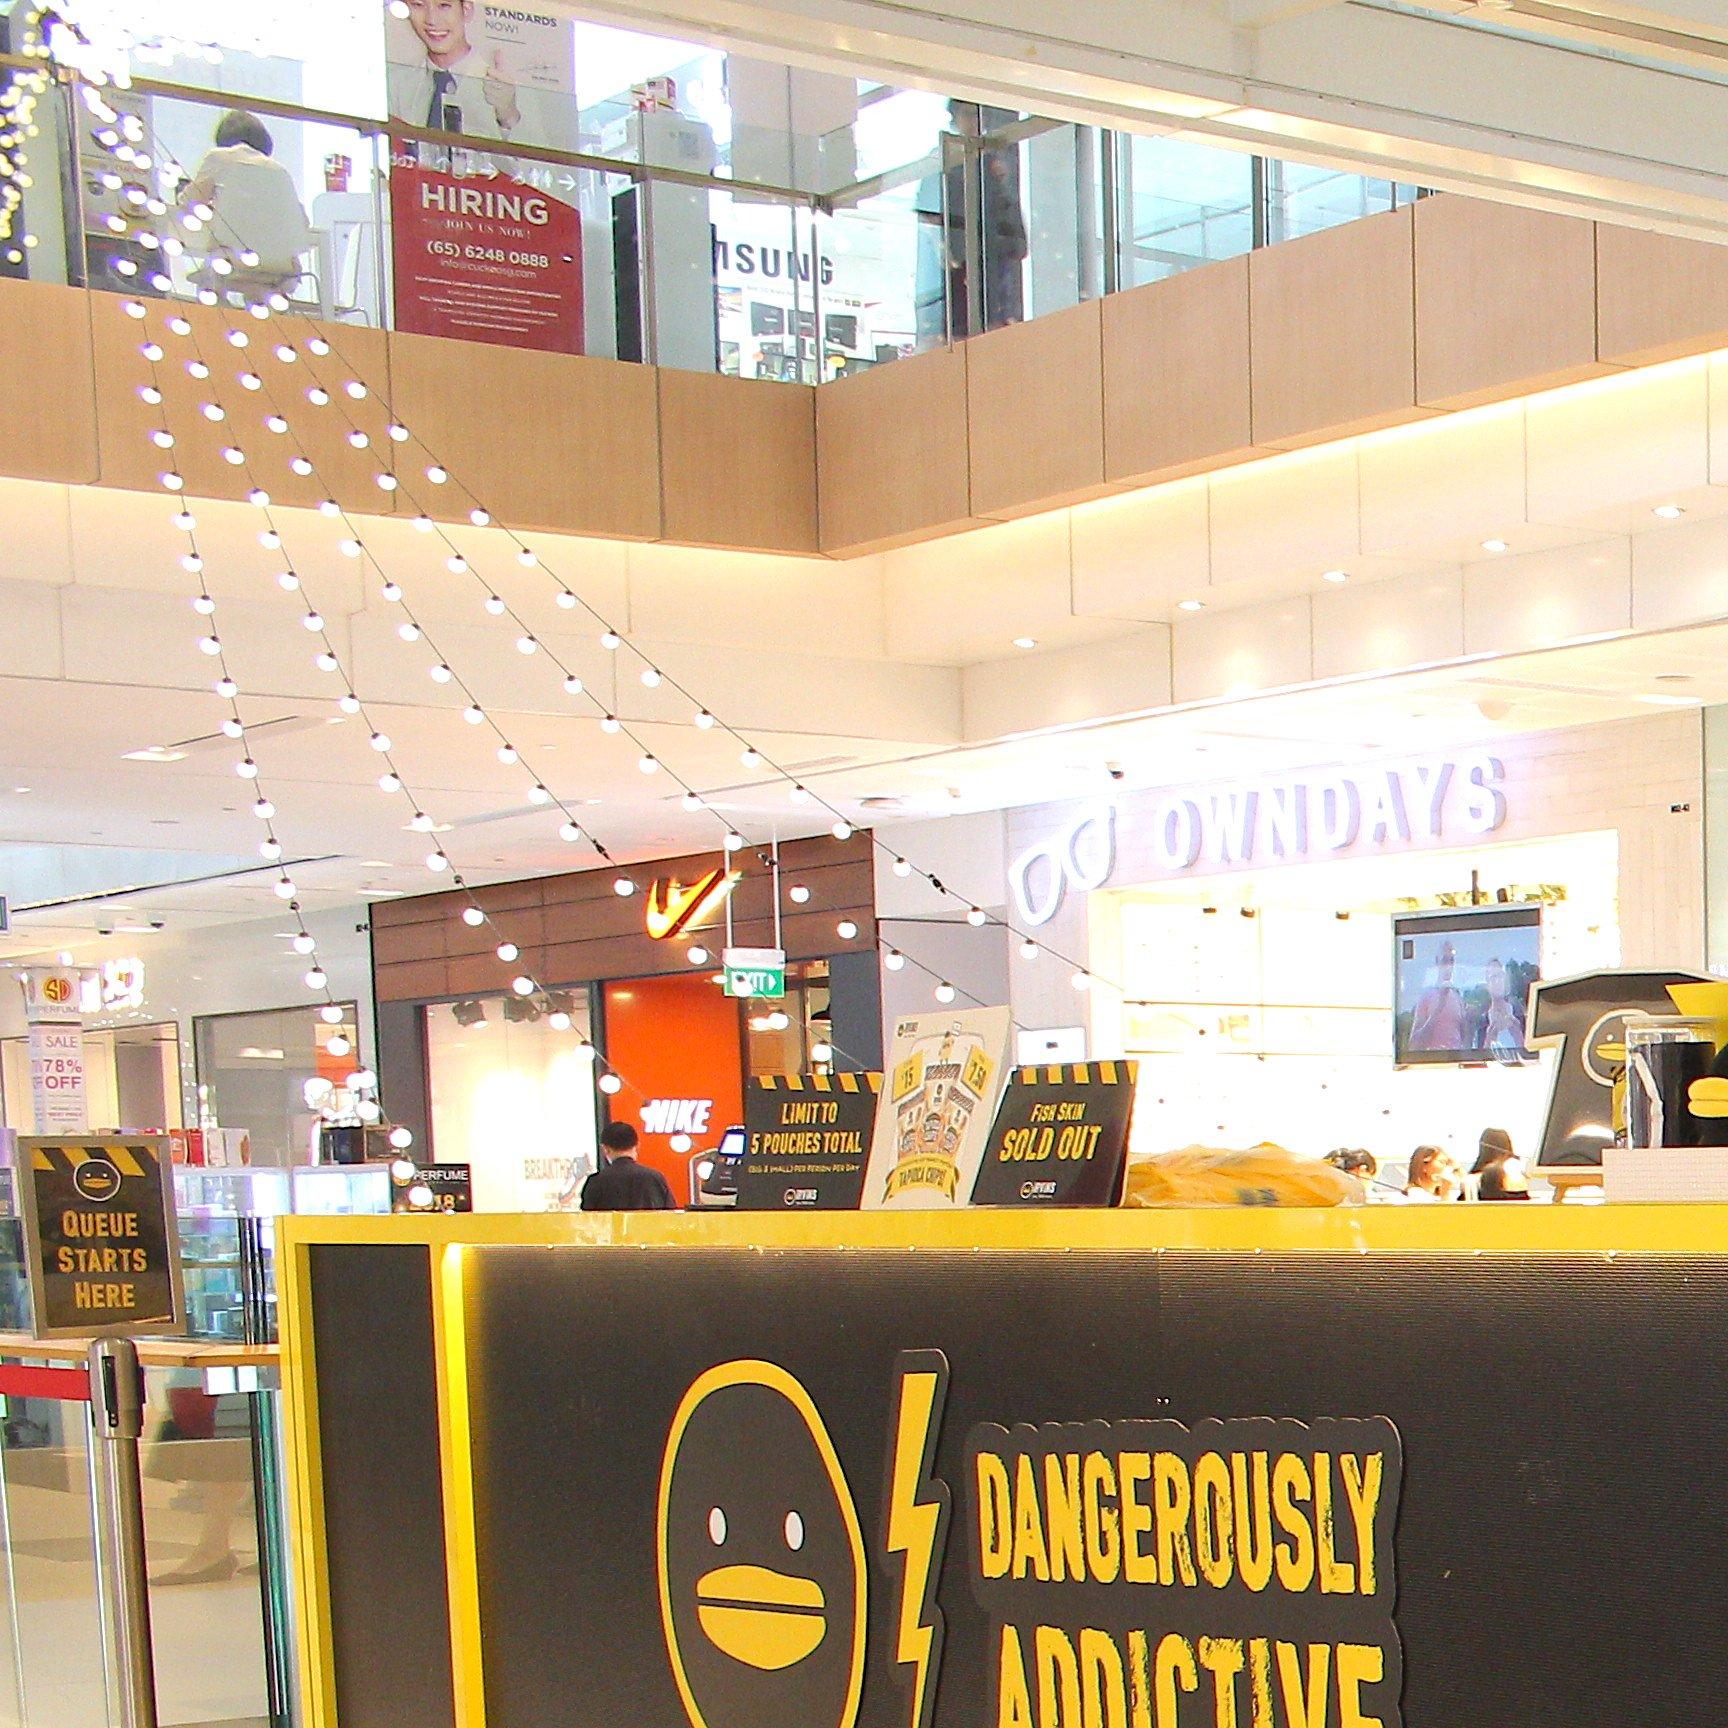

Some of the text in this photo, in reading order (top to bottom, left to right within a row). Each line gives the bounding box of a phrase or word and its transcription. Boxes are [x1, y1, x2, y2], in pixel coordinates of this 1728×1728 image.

[484, 6, 558, 28] STANDARDS
[485, 20, 519, 35] NOW!
[420, 181, 549, 226] HIRING
[445, 217, 473, 232] JOIN
[479, 223, 494, 233] US
[427, 239, 550, 268] (65) 6248 0888
[1155, 754, 1507, 871] OWNDAYS
[45, 1035, 78, 1049] SALE
[43, 1058, 83, 1074] 78%
[45, 1075, 82, 1090] OFF
[643, 1099, 714, 1134] NIKE
[781, 1101, 839, 1125] LIMIT TO
[1030, 1102, 1086, 1123] FISH SKIN
[751, 1131, 863, 1155] 5 POUCHES TOTAL
[999, 1126, 1056, 1163] SOLD
[1056, 1125, 1103, 1161] OUT
[61, 1209, 139, 1239] QUEUE
[57, 1245, 148, 1274] STARTS
[74, 1281, 136, 1309] HERE
[975, 1449, 1384, 1596] DANGEROUSLY
